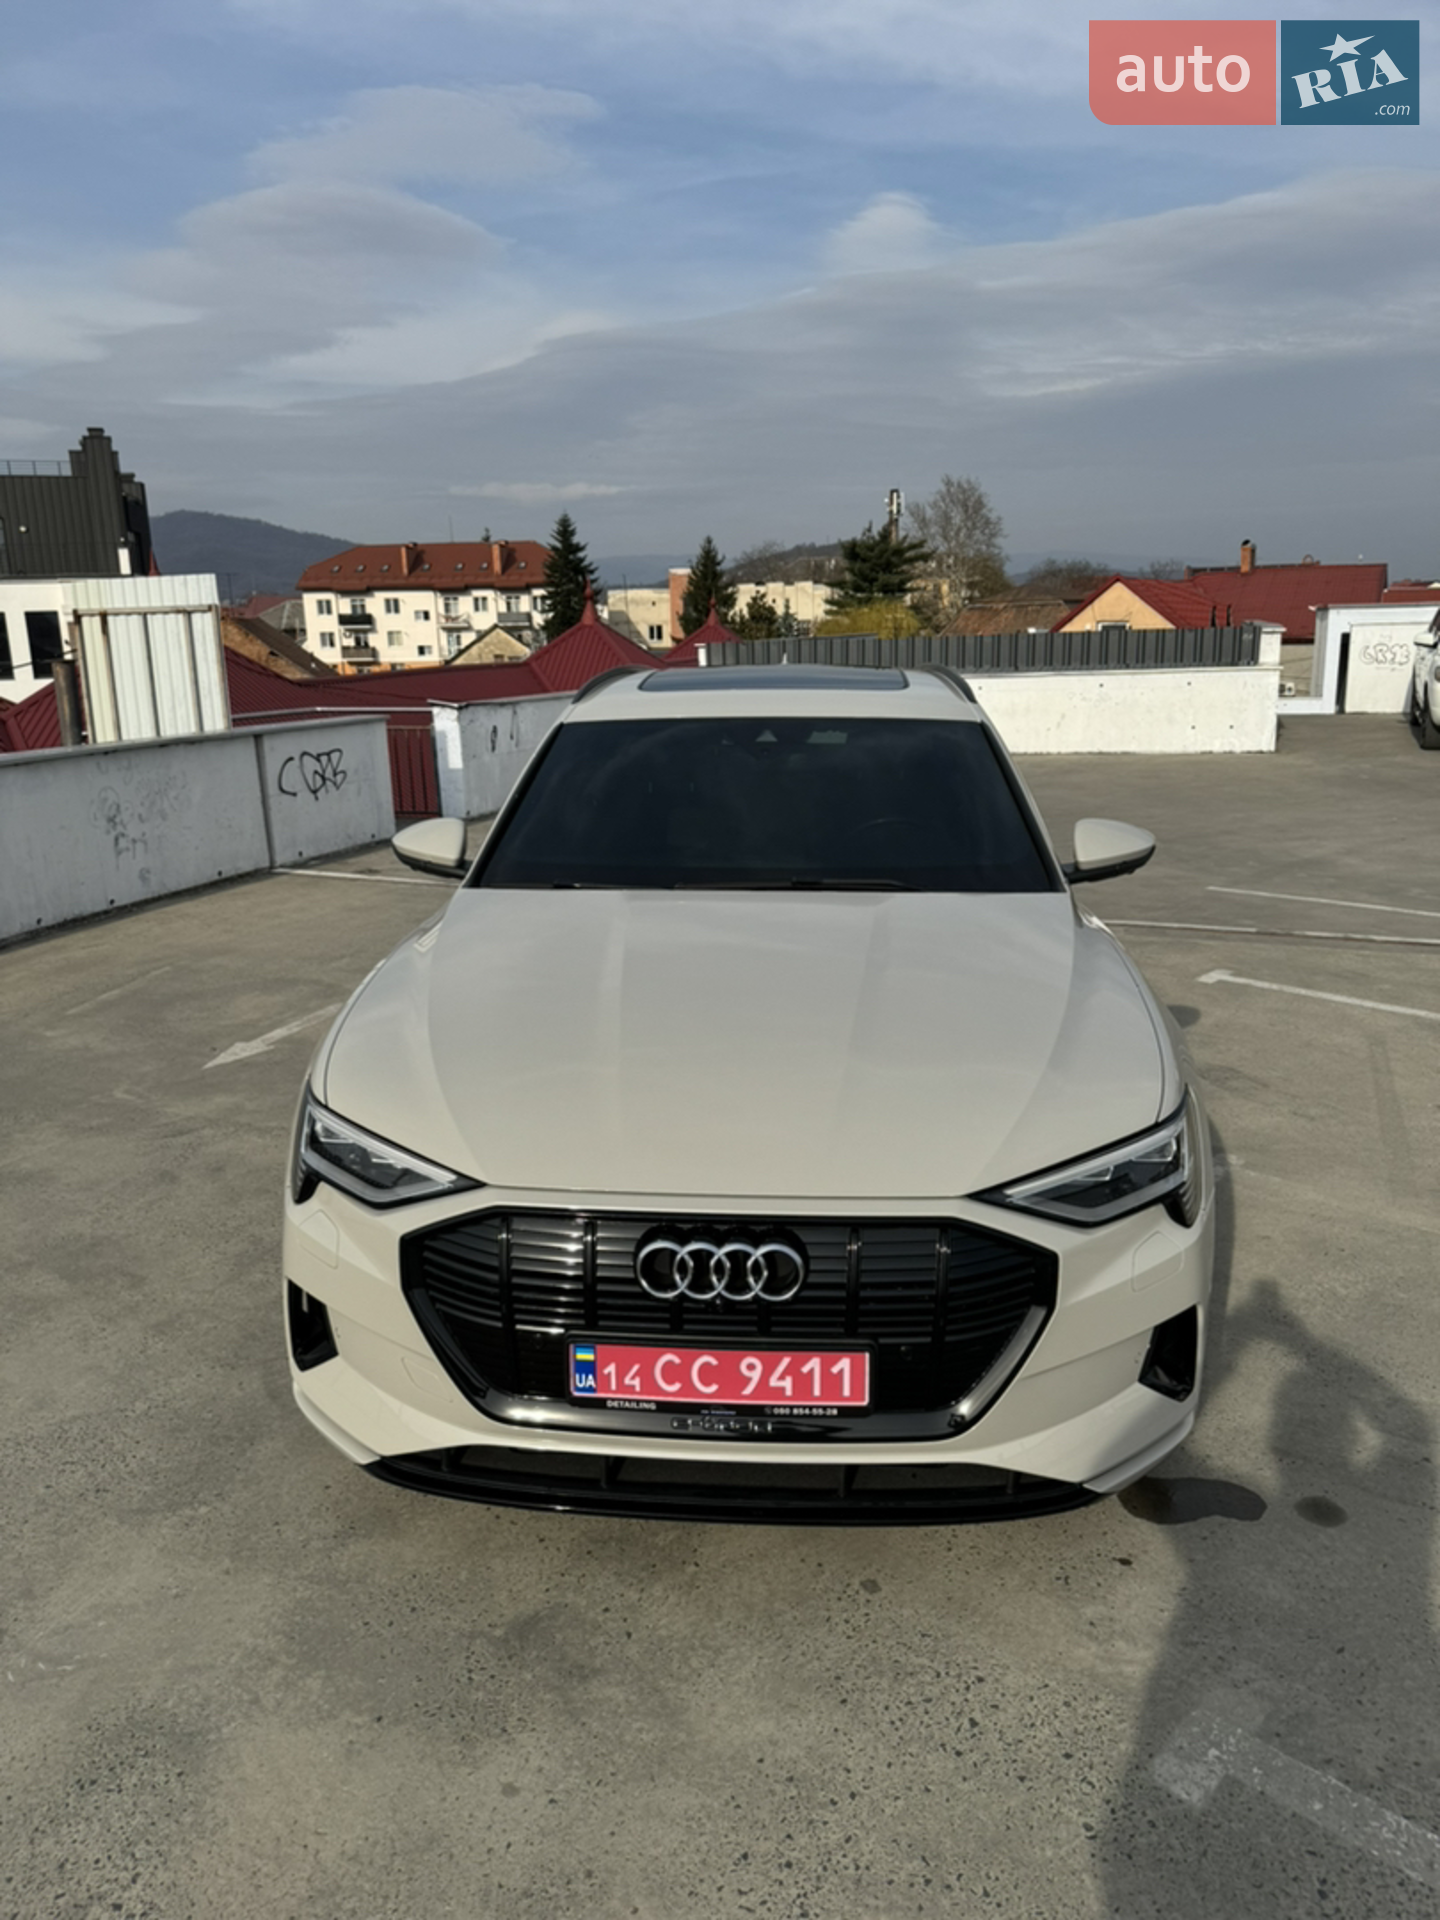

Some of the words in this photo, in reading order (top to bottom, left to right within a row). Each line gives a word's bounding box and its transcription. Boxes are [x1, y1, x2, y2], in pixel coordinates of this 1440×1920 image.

[575, 1373, 597, 1389] UA
[602, 1362, 641, 1392] 14
[653, 1353, 720, 1394] CC
[739, 1356, 851, 1397] 9411
[606, 1399, 657, 1410] DETAILING
